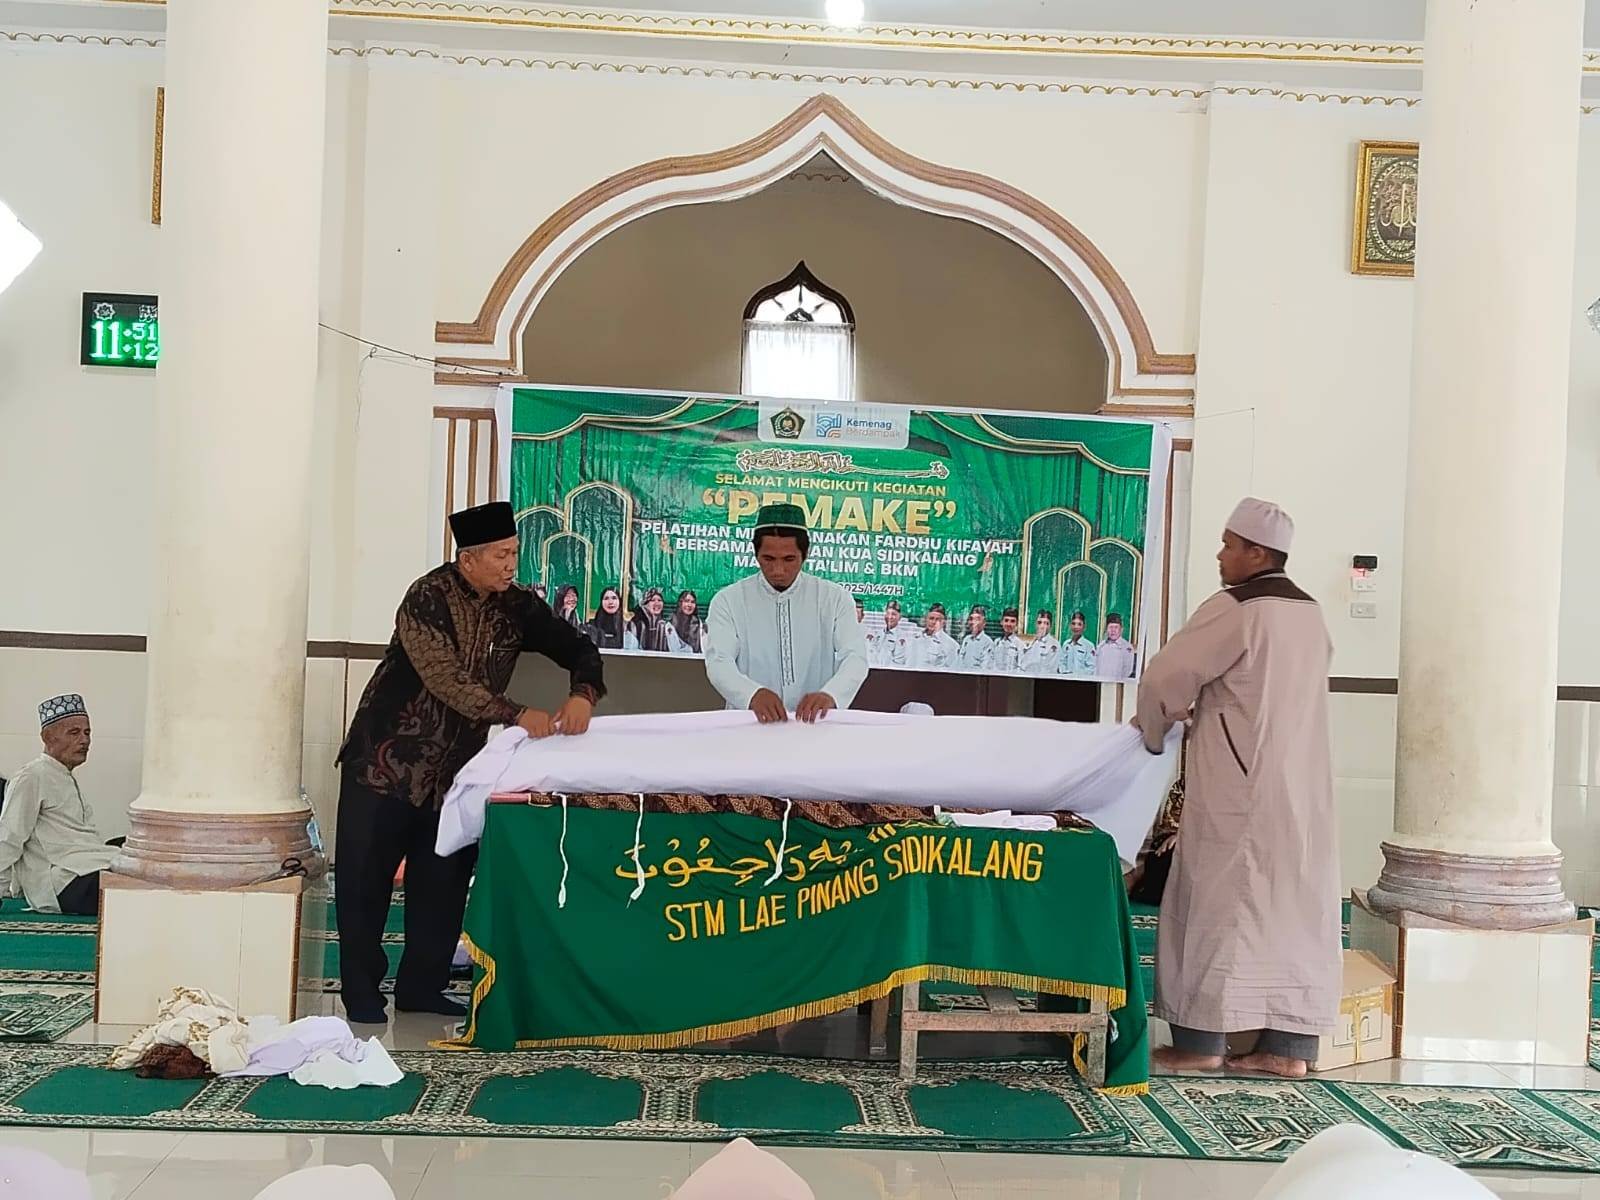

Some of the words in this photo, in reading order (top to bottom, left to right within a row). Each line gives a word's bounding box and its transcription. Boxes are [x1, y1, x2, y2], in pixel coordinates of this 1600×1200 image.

[847, 418, 892, 430] Kemenag
[715, 473, 784, 488] SELAMAT
[788, 478, 868, 492] MENGIKUTI
[873, 482, 947, 496] KEGIATAN
[641, 522, 730, 538] PELATIHAN
[875, 535, 941, 550] FARDHU
[947, 539, 1014, 554] KIFAYAH
[676, 538, 756, 553] BERSAMA
[839, 548, 872, 560] KUA
[877, 550, 977, 566] SIDIKALANG
[864, 562, 875, 574] &
[881, 563, 918, 576] BKM
[665, 899, 725, 940] STM
[740, 894, 786, 932] LAE
[797, 858, 878, 919] PINANG
[884, 835, 1044, 881] SIDIKALANG
